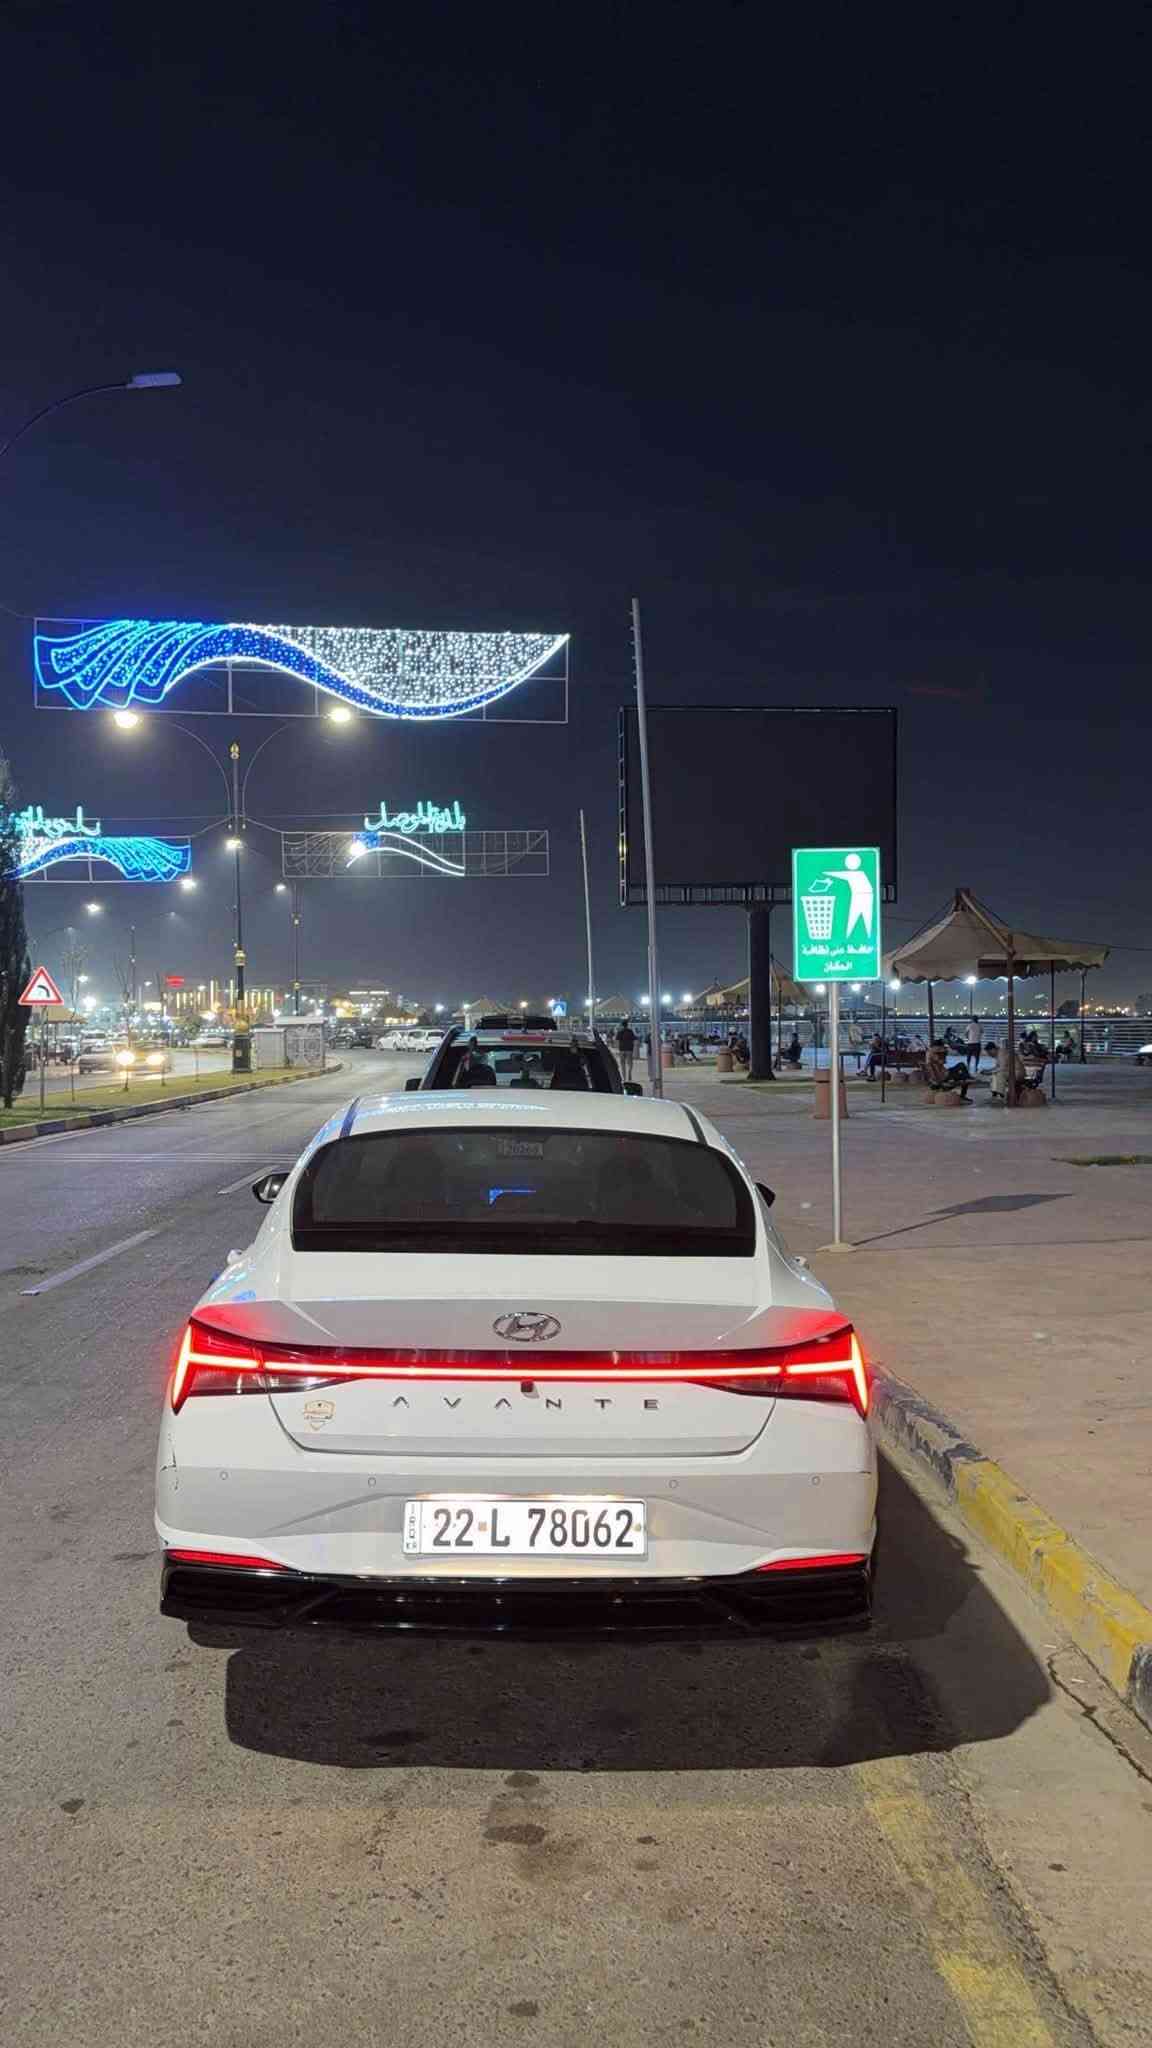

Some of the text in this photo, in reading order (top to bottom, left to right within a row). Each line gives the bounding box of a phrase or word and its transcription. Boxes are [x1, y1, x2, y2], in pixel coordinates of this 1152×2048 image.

[830, 944, 845, 957] على
[824, 960, 853, 973] المكان
[392, 1395, 660, 1410] AVANTE
[433, 1508, 634, 1548] 22 L 78062
